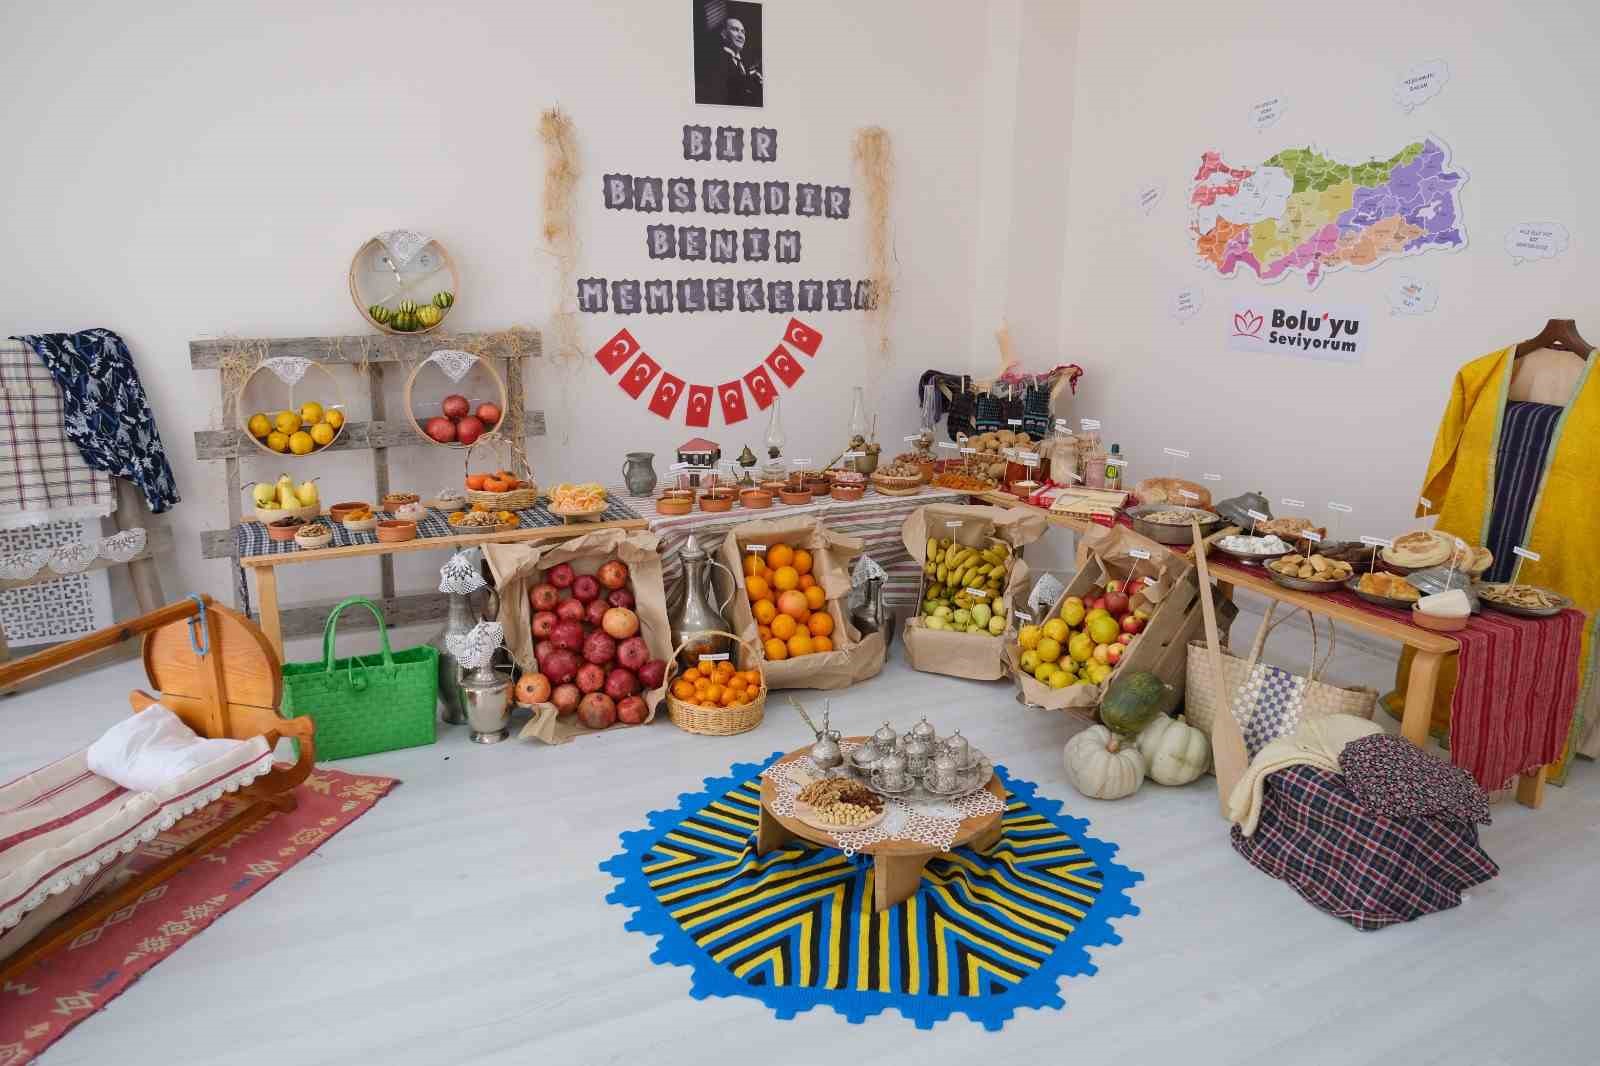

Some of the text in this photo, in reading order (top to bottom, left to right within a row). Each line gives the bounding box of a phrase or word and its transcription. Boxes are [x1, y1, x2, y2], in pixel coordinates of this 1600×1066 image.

[688, 129, 773, 159] BIR
[607, 178, 846, 216] BASKADIR
[652, 228, 799, 261] BENIM
[1271, 308, 1360, 339] Bolu'yu
[1268, 331, 1357, 352] Seviyorum
